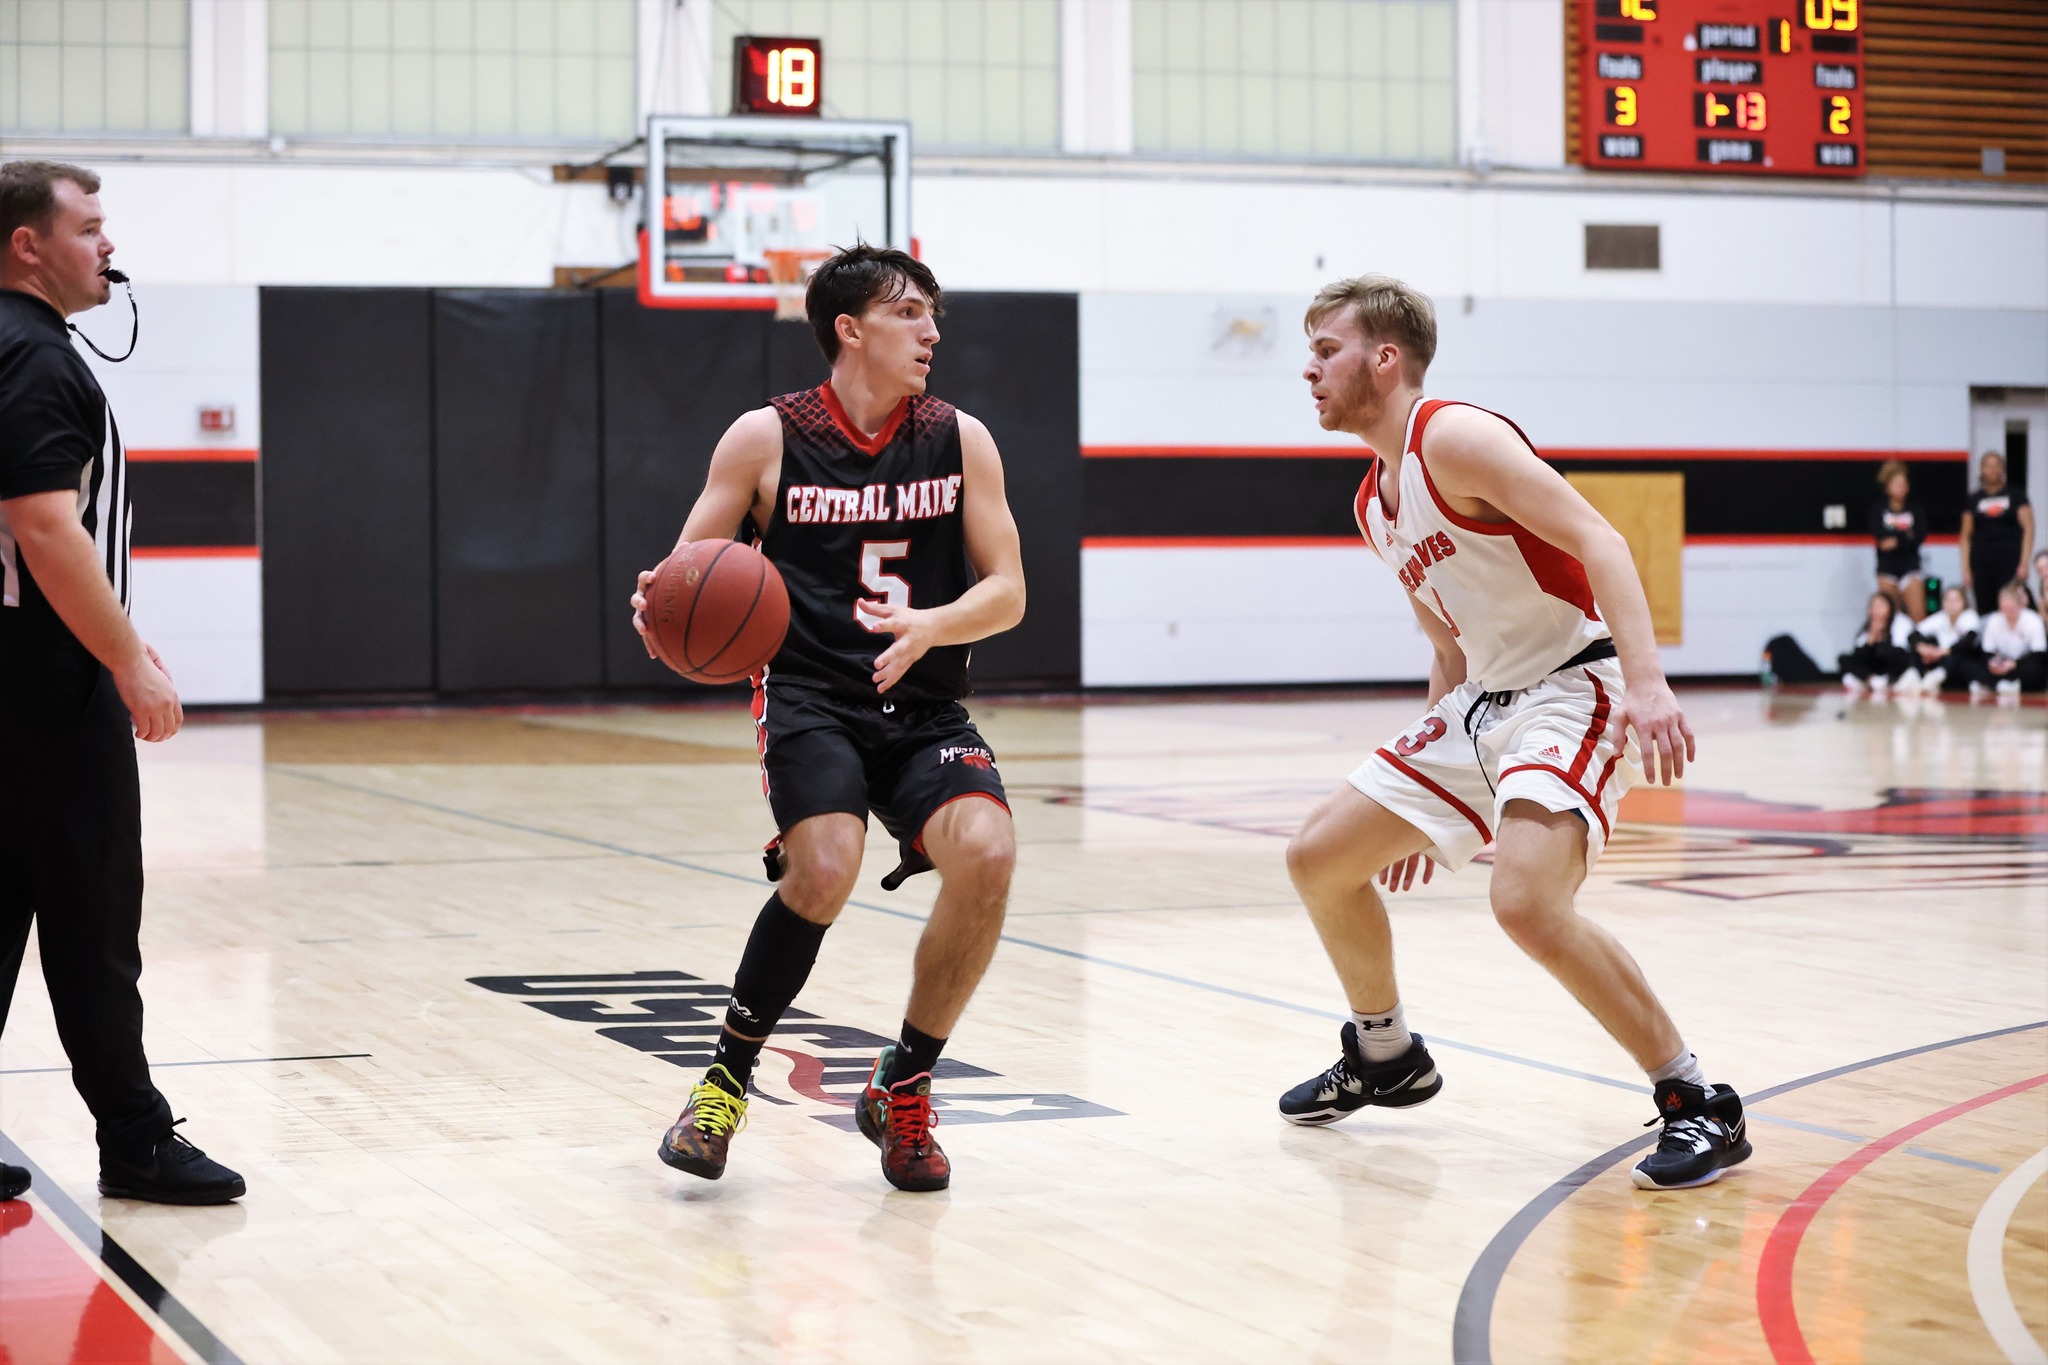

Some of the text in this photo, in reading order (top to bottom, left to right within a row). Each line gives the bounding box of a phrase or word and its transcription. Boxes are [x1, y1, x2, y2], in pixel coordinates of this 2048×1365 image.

[1780, 19, 1790, 53] 1
[767, 47, 815, 107] 18
[1615, 87, 1636, 126] 3
[1829, 96, 1850, 134] 2
[787, 474, 962, 523] CENTRAL MAINE
[853, 539, 911, 633] 5
